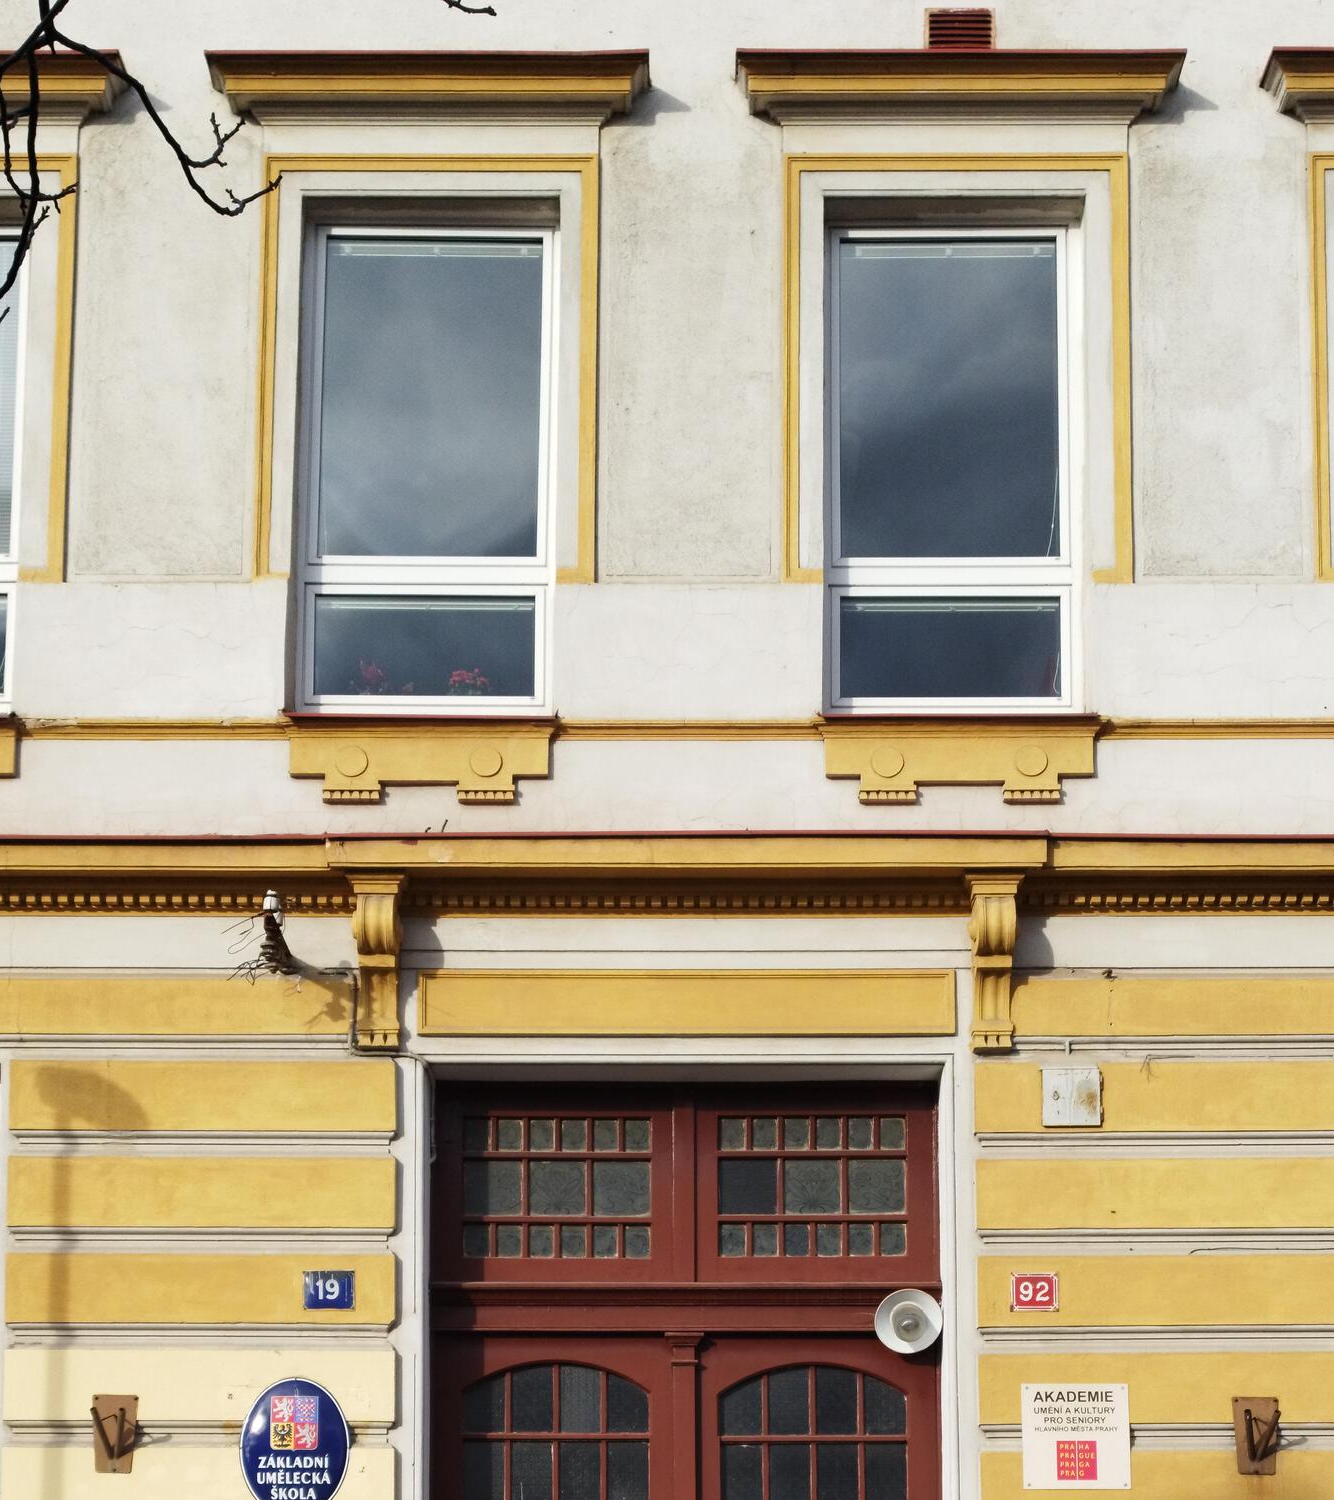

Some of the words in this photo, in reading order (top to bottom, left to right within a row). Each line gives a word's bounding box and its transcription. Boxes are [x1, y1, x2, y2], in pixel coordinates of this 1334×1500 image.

[316, 1279, 339, 1300] 19
[1019, 1282, 1050, 1302] 92
[1034, 1391, 1113, 1402] AKADEMIE
[1034, 1406, 1062, 1414] UMĚNÍ
[258, 1453, 329, 1469] ZÁKLADNÍ
[257, 1470, 330, 1485] UMĚLECKÁ
[271, 1483, 316, 1500] ŠKOLA
